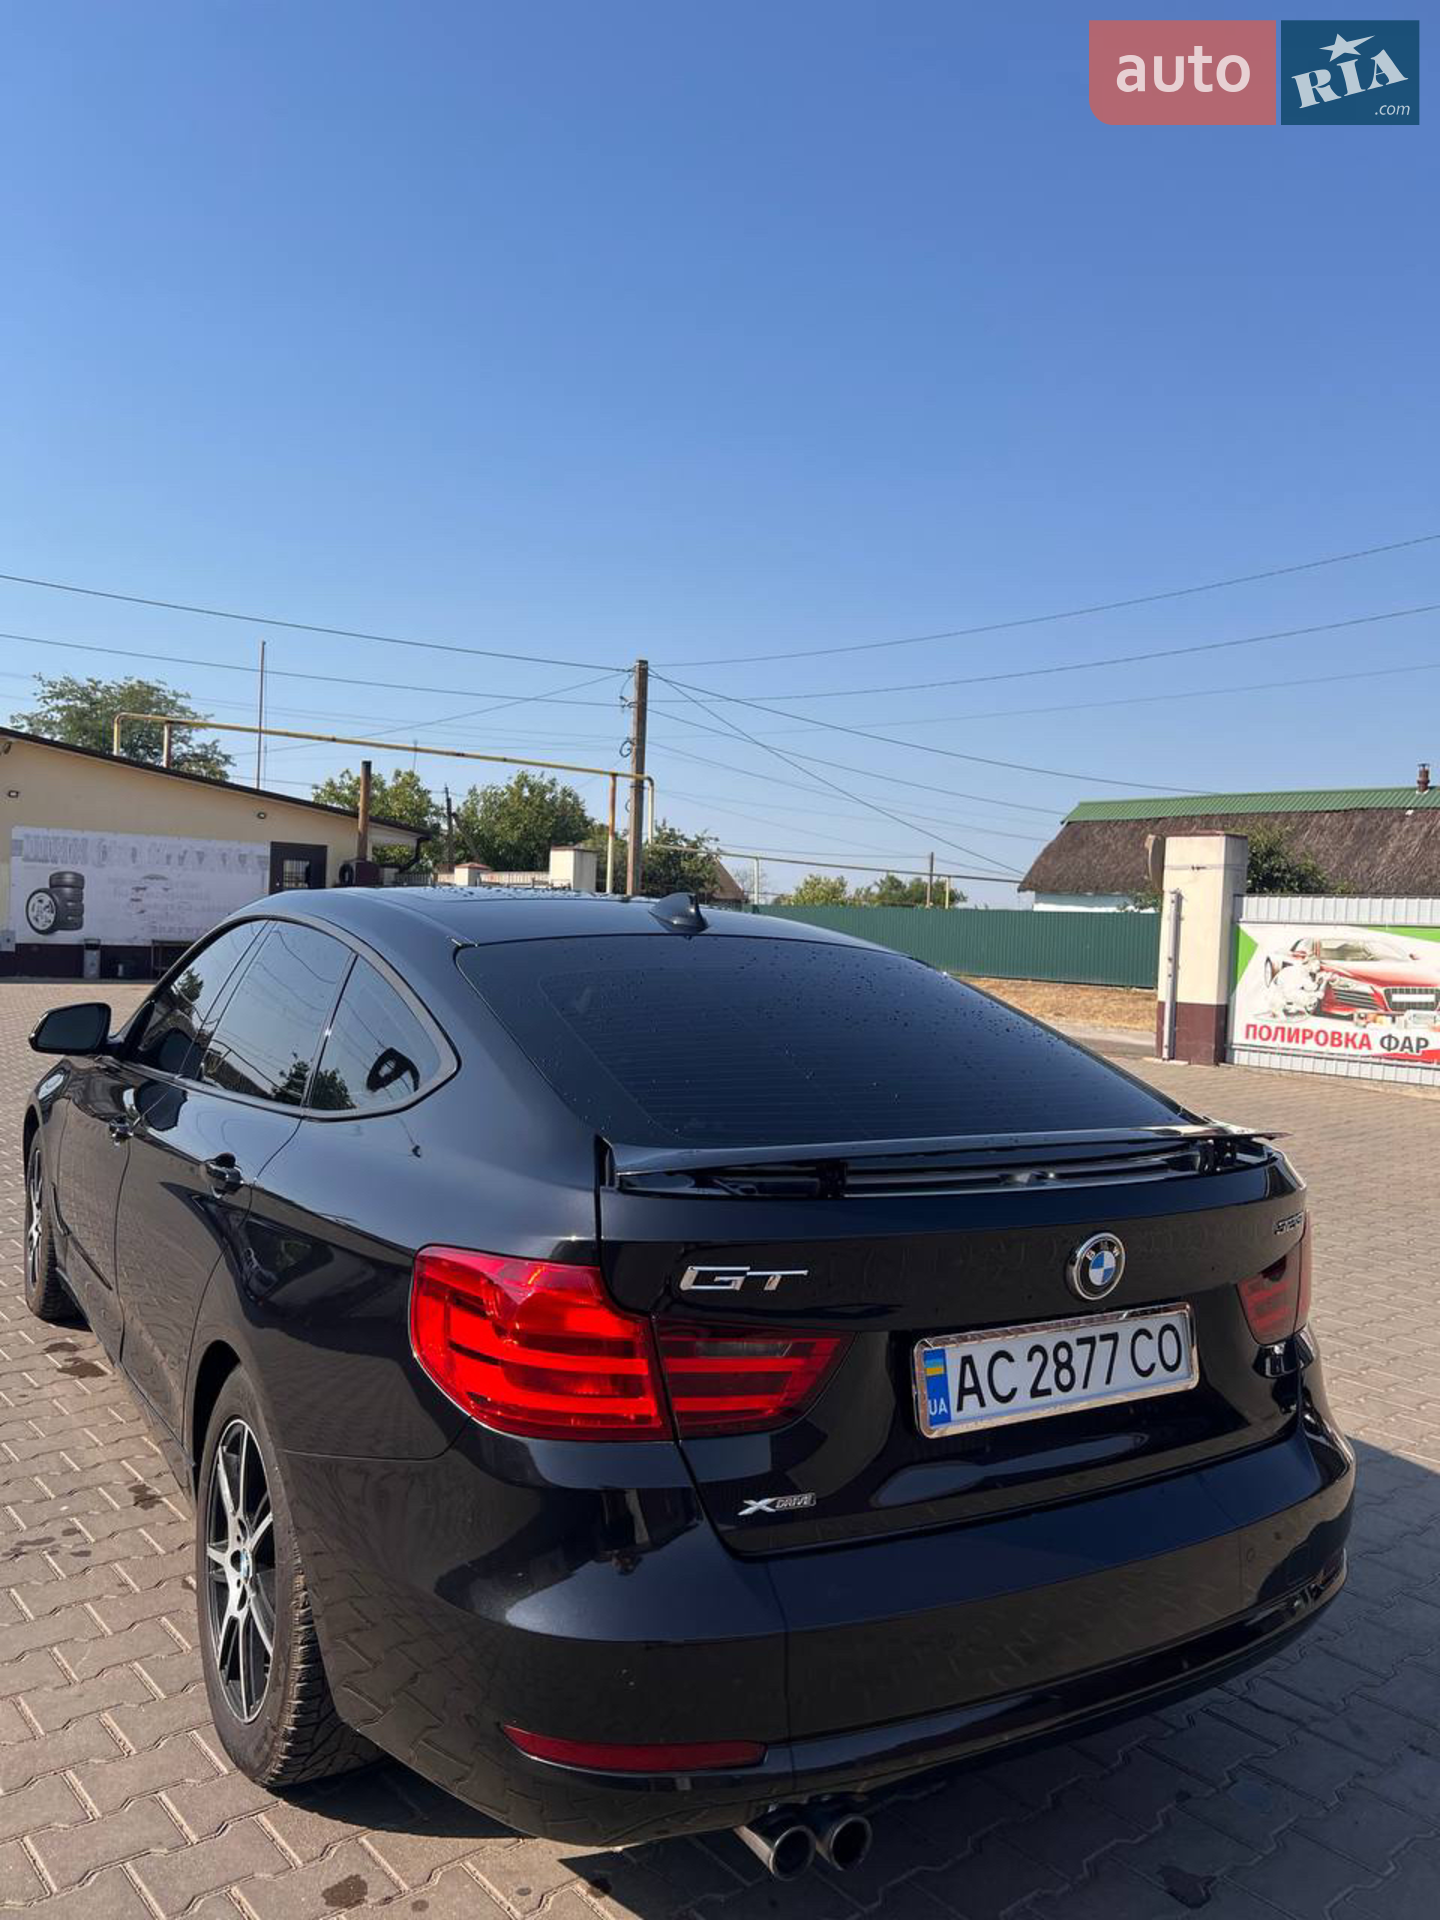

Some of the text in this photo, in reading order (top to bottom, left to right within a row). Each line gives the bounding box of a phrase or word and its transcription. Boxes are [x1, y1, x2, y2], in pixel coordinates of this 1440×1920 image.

[1245, 1023, 1430, 1054] ПОЛИРОВКА ФАР
[679, 1265, 809, 1291] GT
[956, 1322, 1183, 1412] AC 2877 CO
[928, 1398, 948, 1417] UA
